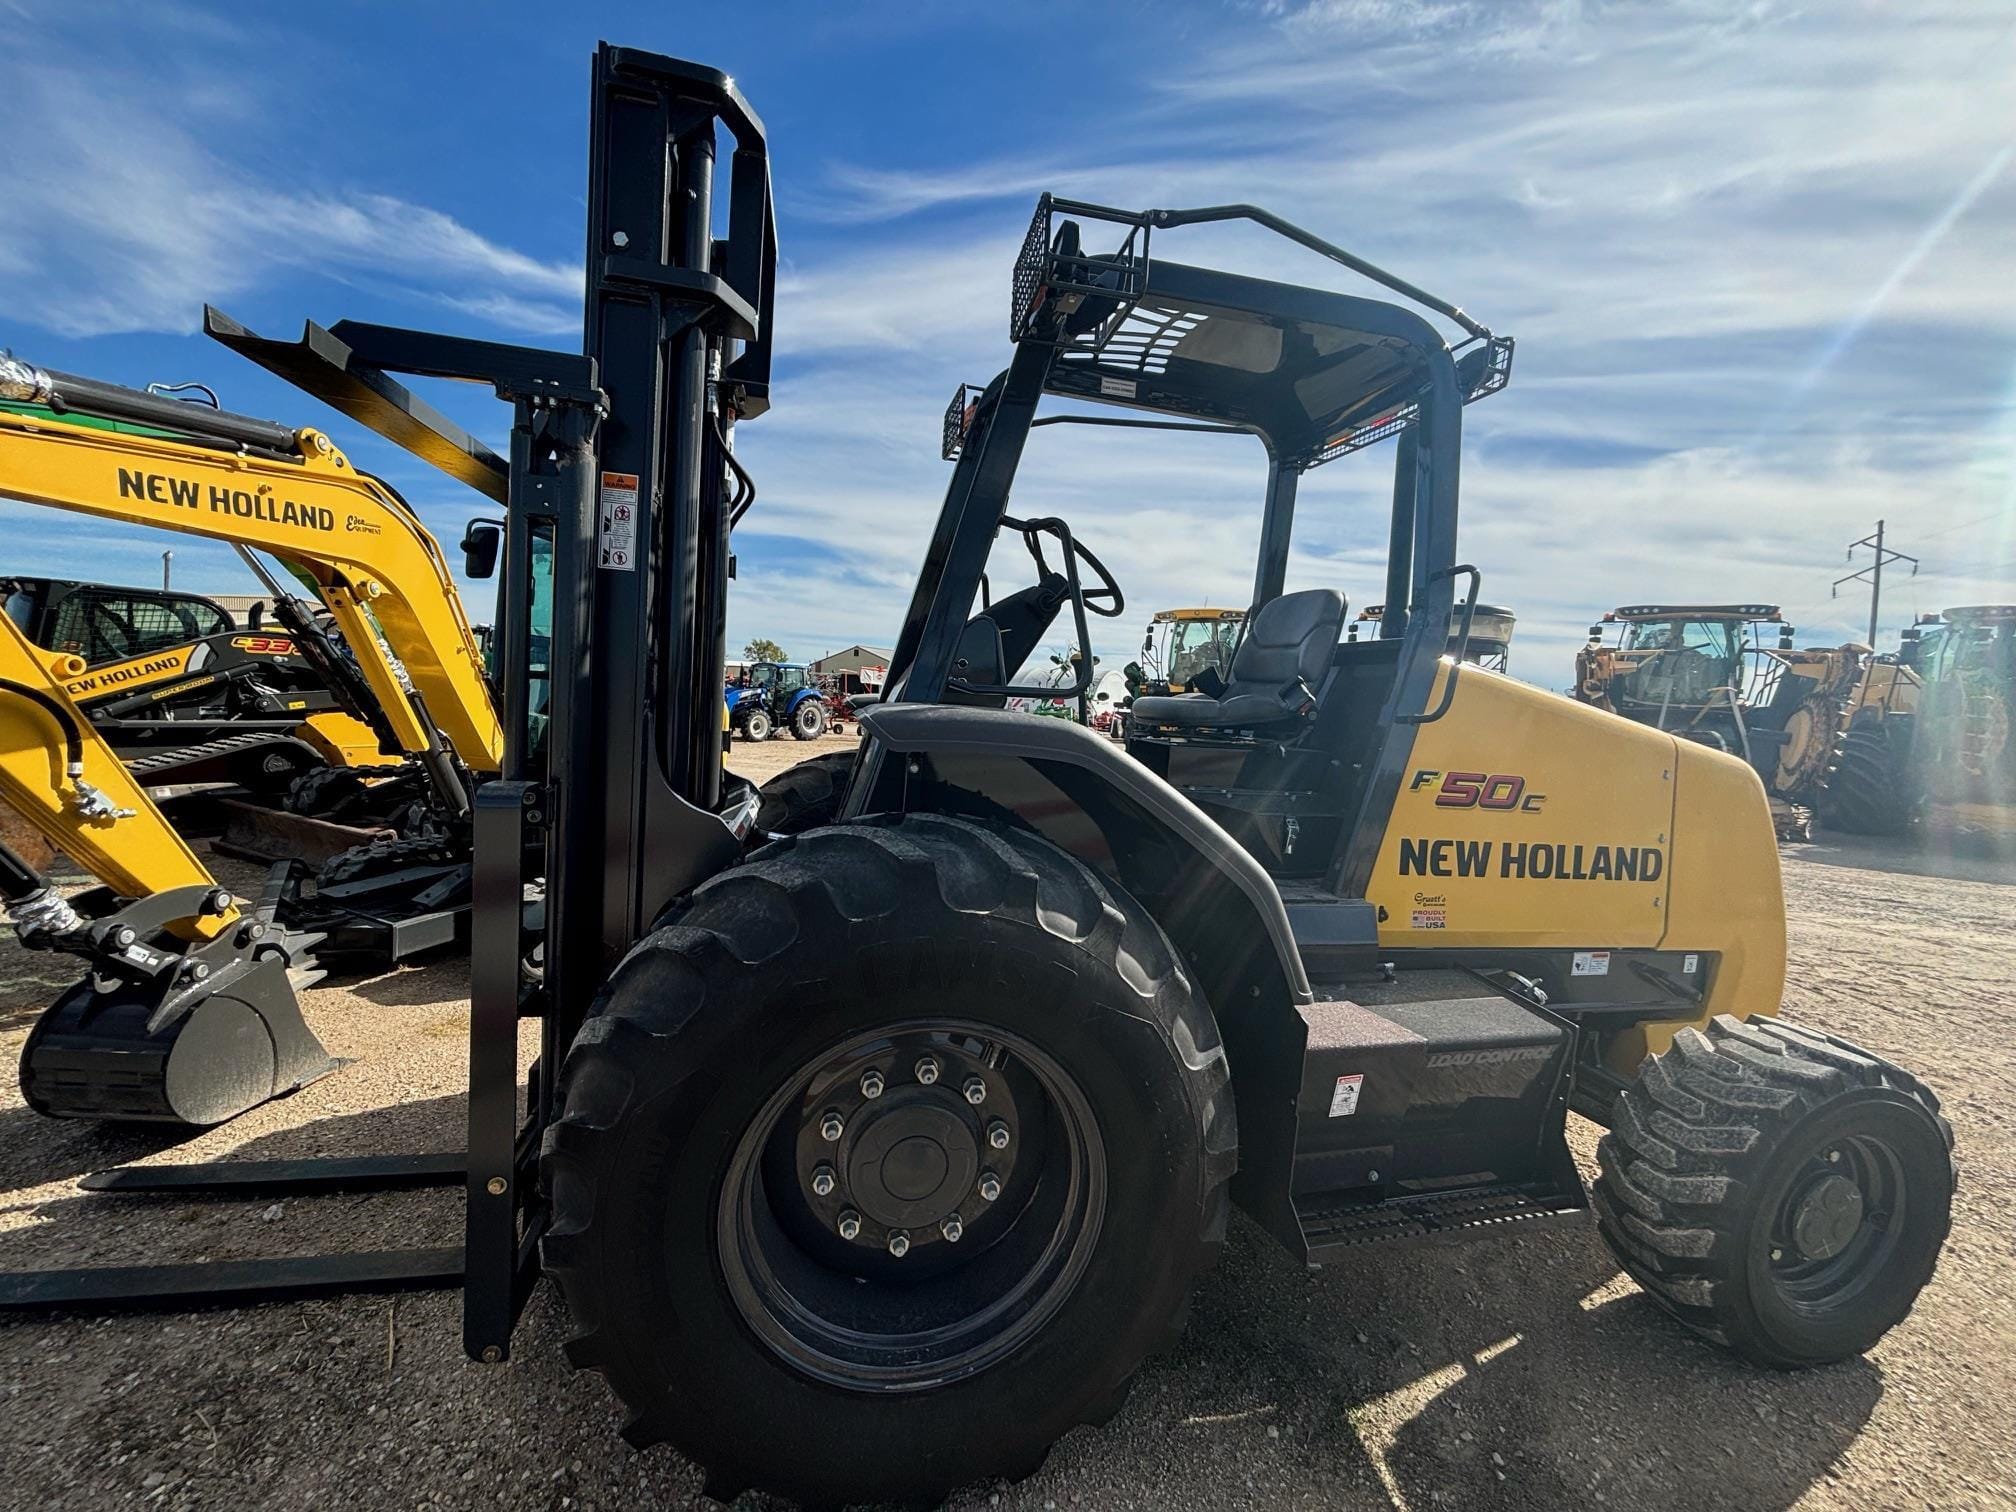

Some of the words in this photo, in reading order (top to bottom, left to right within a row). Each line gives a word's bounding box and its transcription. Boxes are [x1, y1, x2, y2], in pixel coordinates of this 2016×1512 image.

[118, 467, 199, 509] NEW
[208, 485, 335, 531] HOLLAND
[100, 656, 180, 687] HOLLAND
[1399, 838, 1492, 878] NEW
[1500, 842, 1663, 882] HOLLAND
[1426, 1053, 1475, 1068] LOAD
